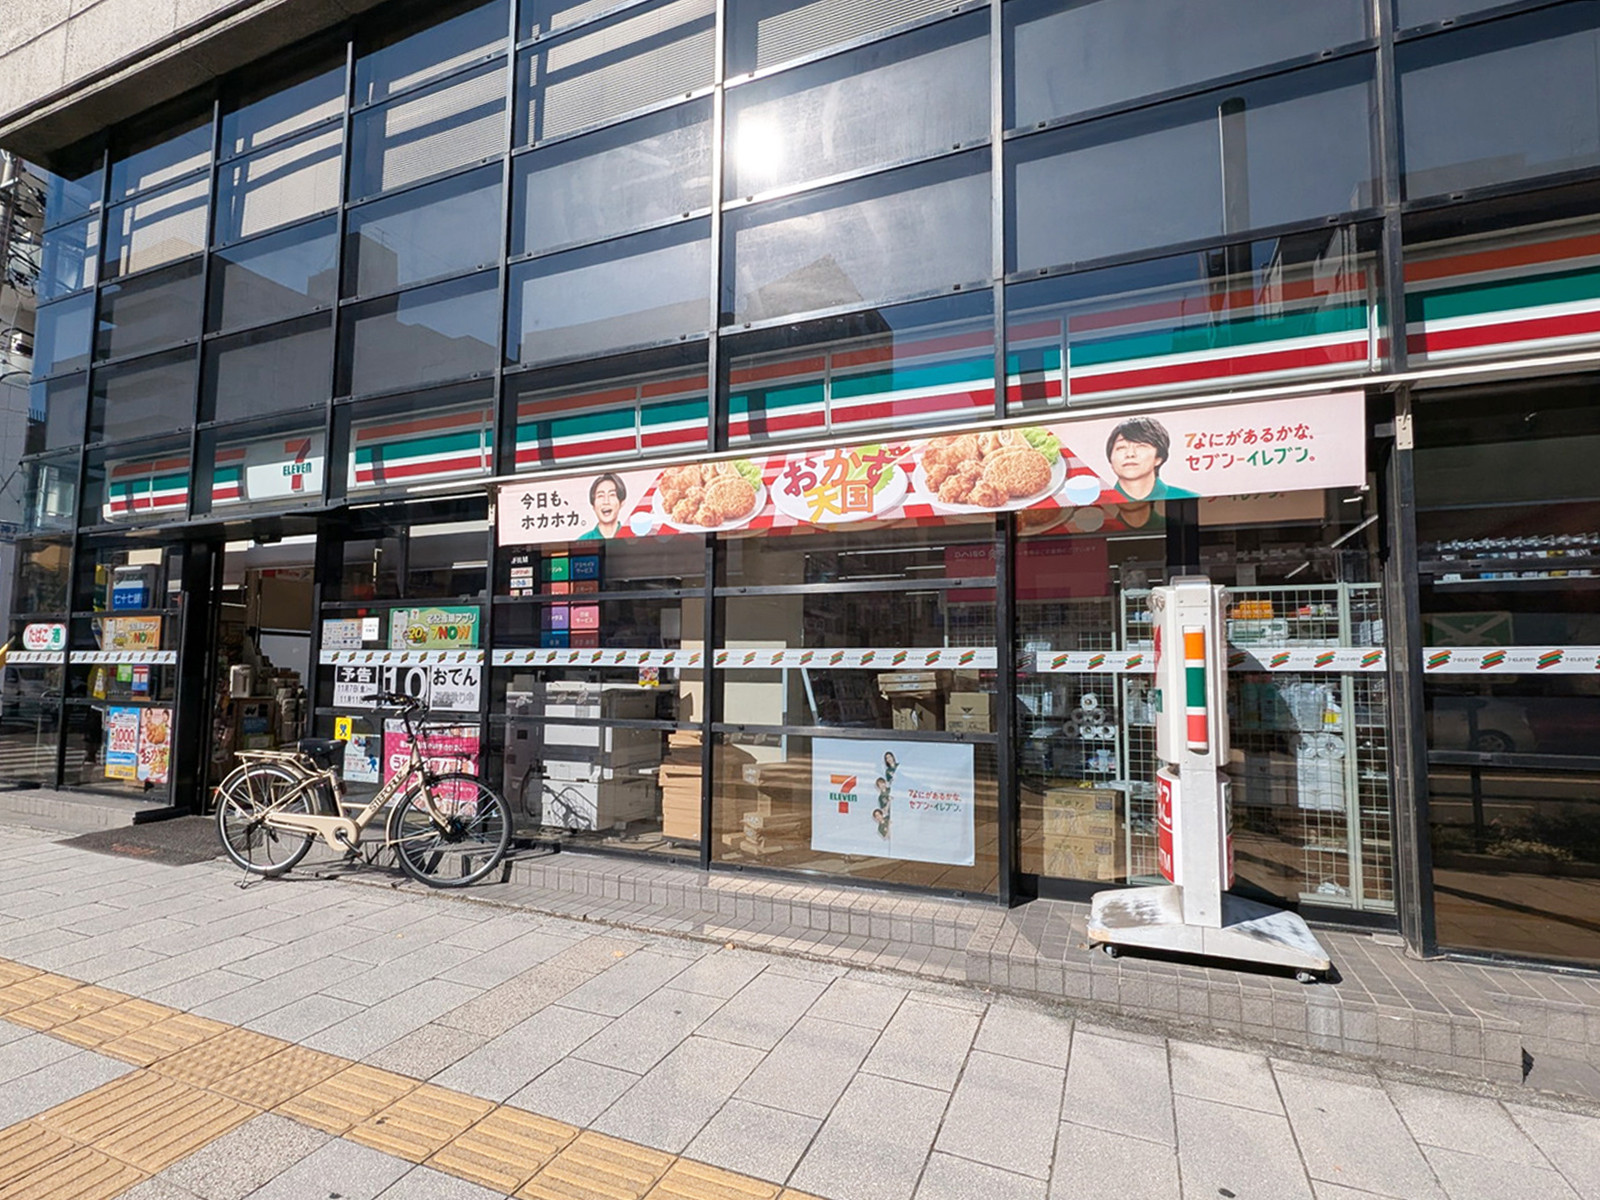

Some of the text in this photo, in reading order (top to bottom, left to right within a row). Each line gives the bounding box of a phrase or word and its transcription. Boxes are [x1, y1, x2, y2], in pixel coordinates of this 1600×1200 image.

[520, 490, 569, 509] 今日も、
[803, 480, 873, 523] 天国
[521, 510, 587, 530] ホカホカ。
[28, 629, 48, 643] たばこ
[51, 628, 61, 643] 酒
[341, 667, 372, 682] 予告
[433, 668, 478, 687] おでん
